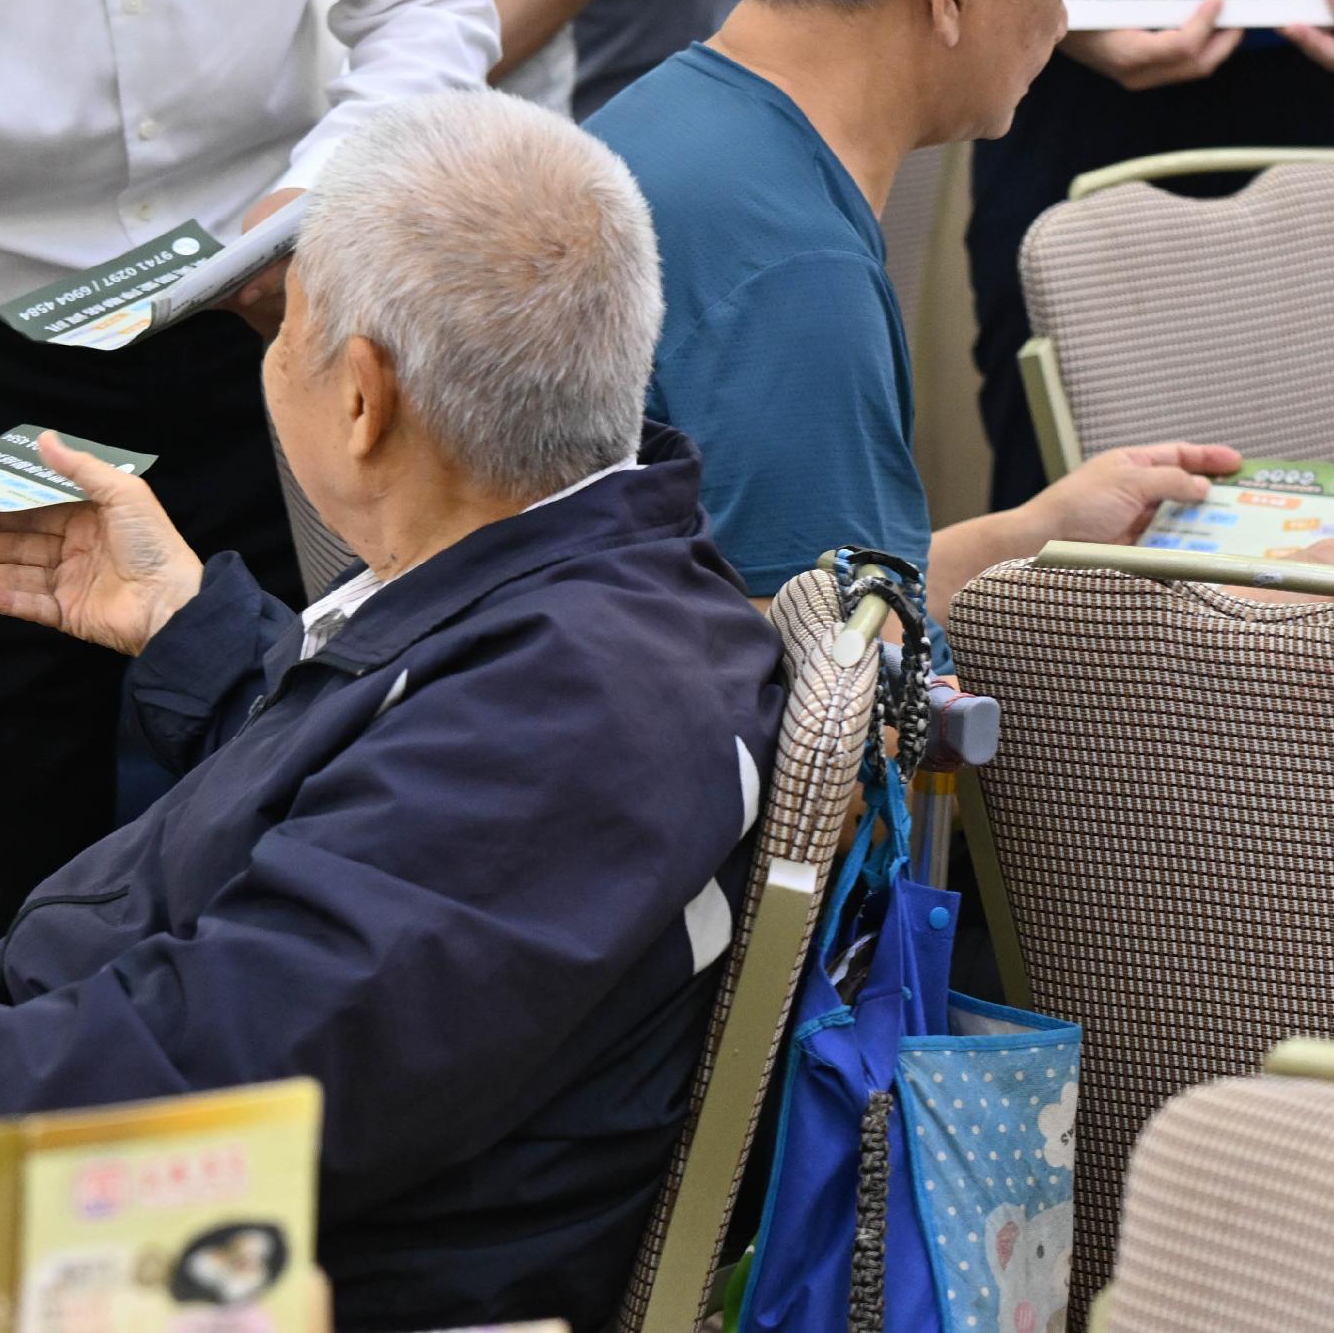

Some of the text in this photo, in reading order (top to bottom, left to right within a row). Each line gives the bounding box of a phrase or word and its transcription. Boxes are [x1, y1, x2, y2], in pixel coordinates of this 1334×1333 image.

[137, 249, 173, 272] 9741
[91, 279, 100, 292] /
[101, 265, 138, 288] 0297
[54, 284, 92, 306] 6904
[18, 300, 55, 322] 4584
